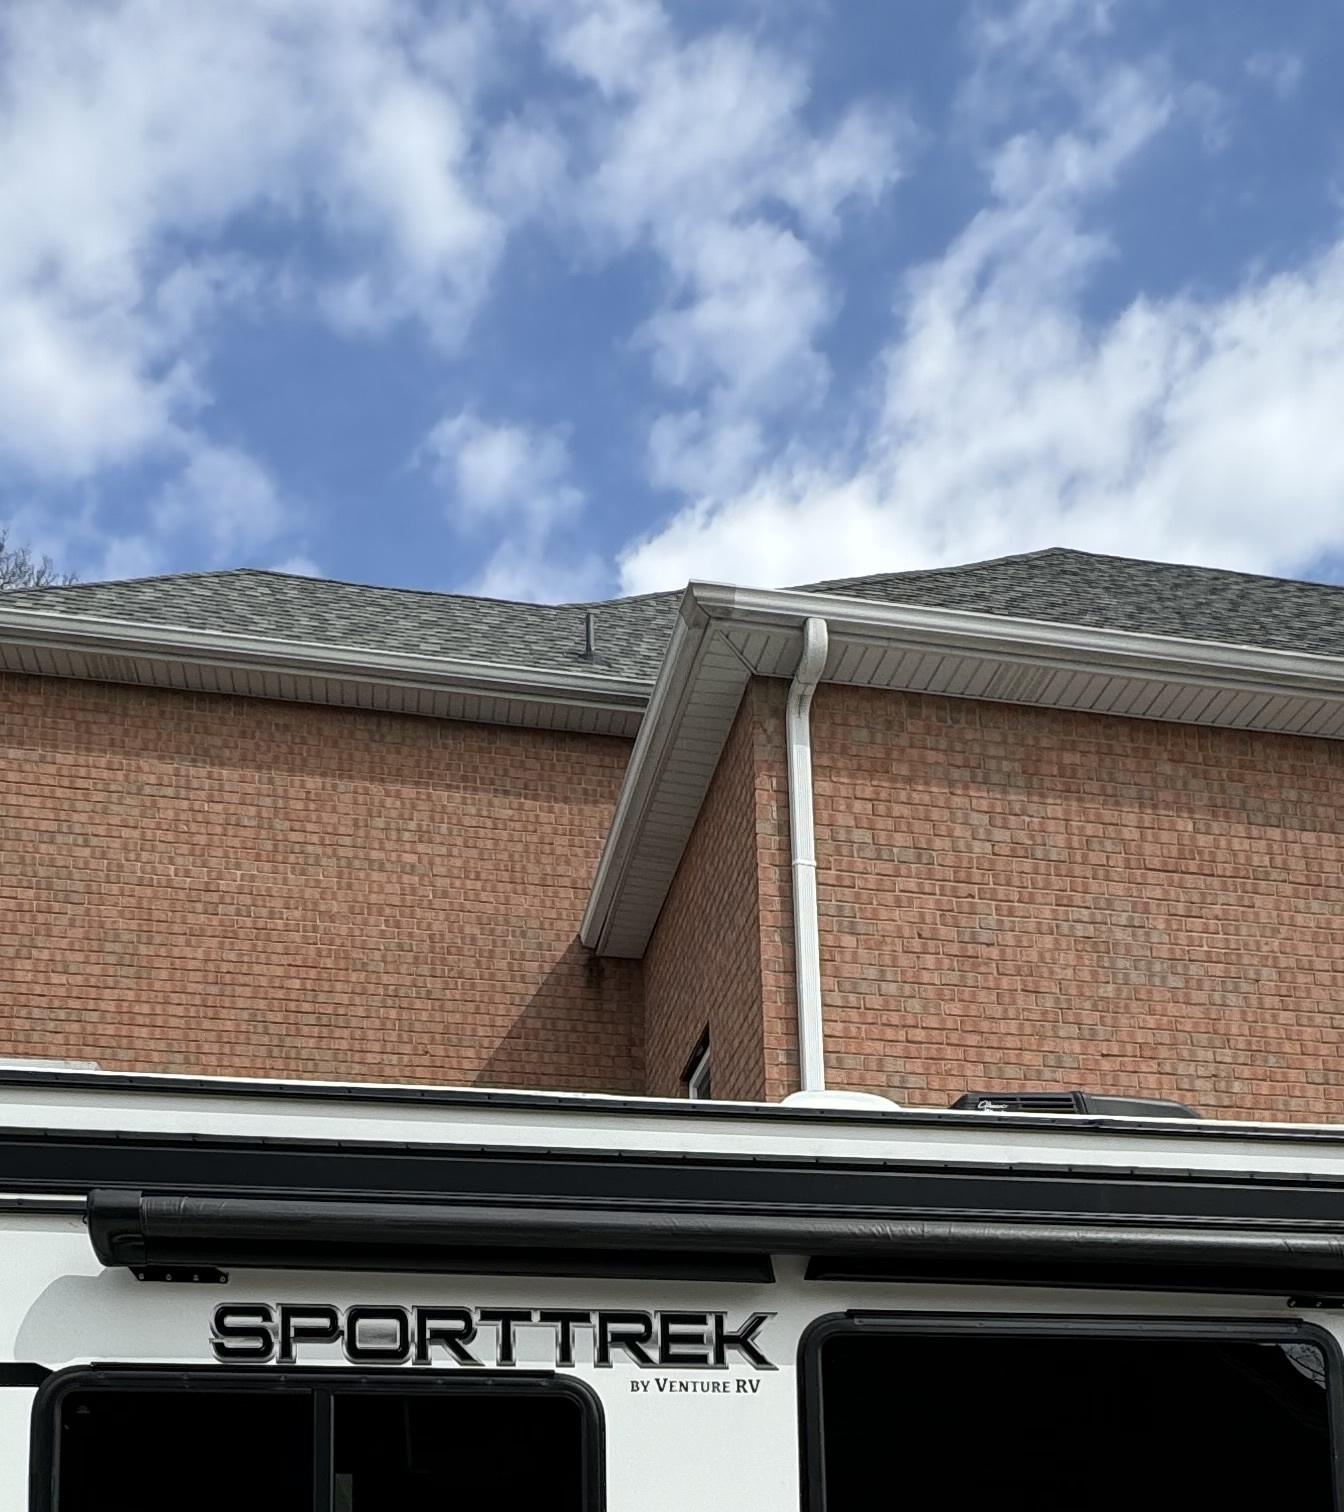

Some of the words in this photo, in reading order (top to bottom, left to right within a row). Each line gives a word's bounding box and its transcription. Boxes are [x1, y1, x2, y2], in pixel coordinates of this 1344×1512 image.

[208, 1302, 780, 1370] SPORTTREK
[630, 1380, 651, 1393] BY
[654, 1377, 731, 1393] VENTURE
[735, 1379, 761, 1393] RV
